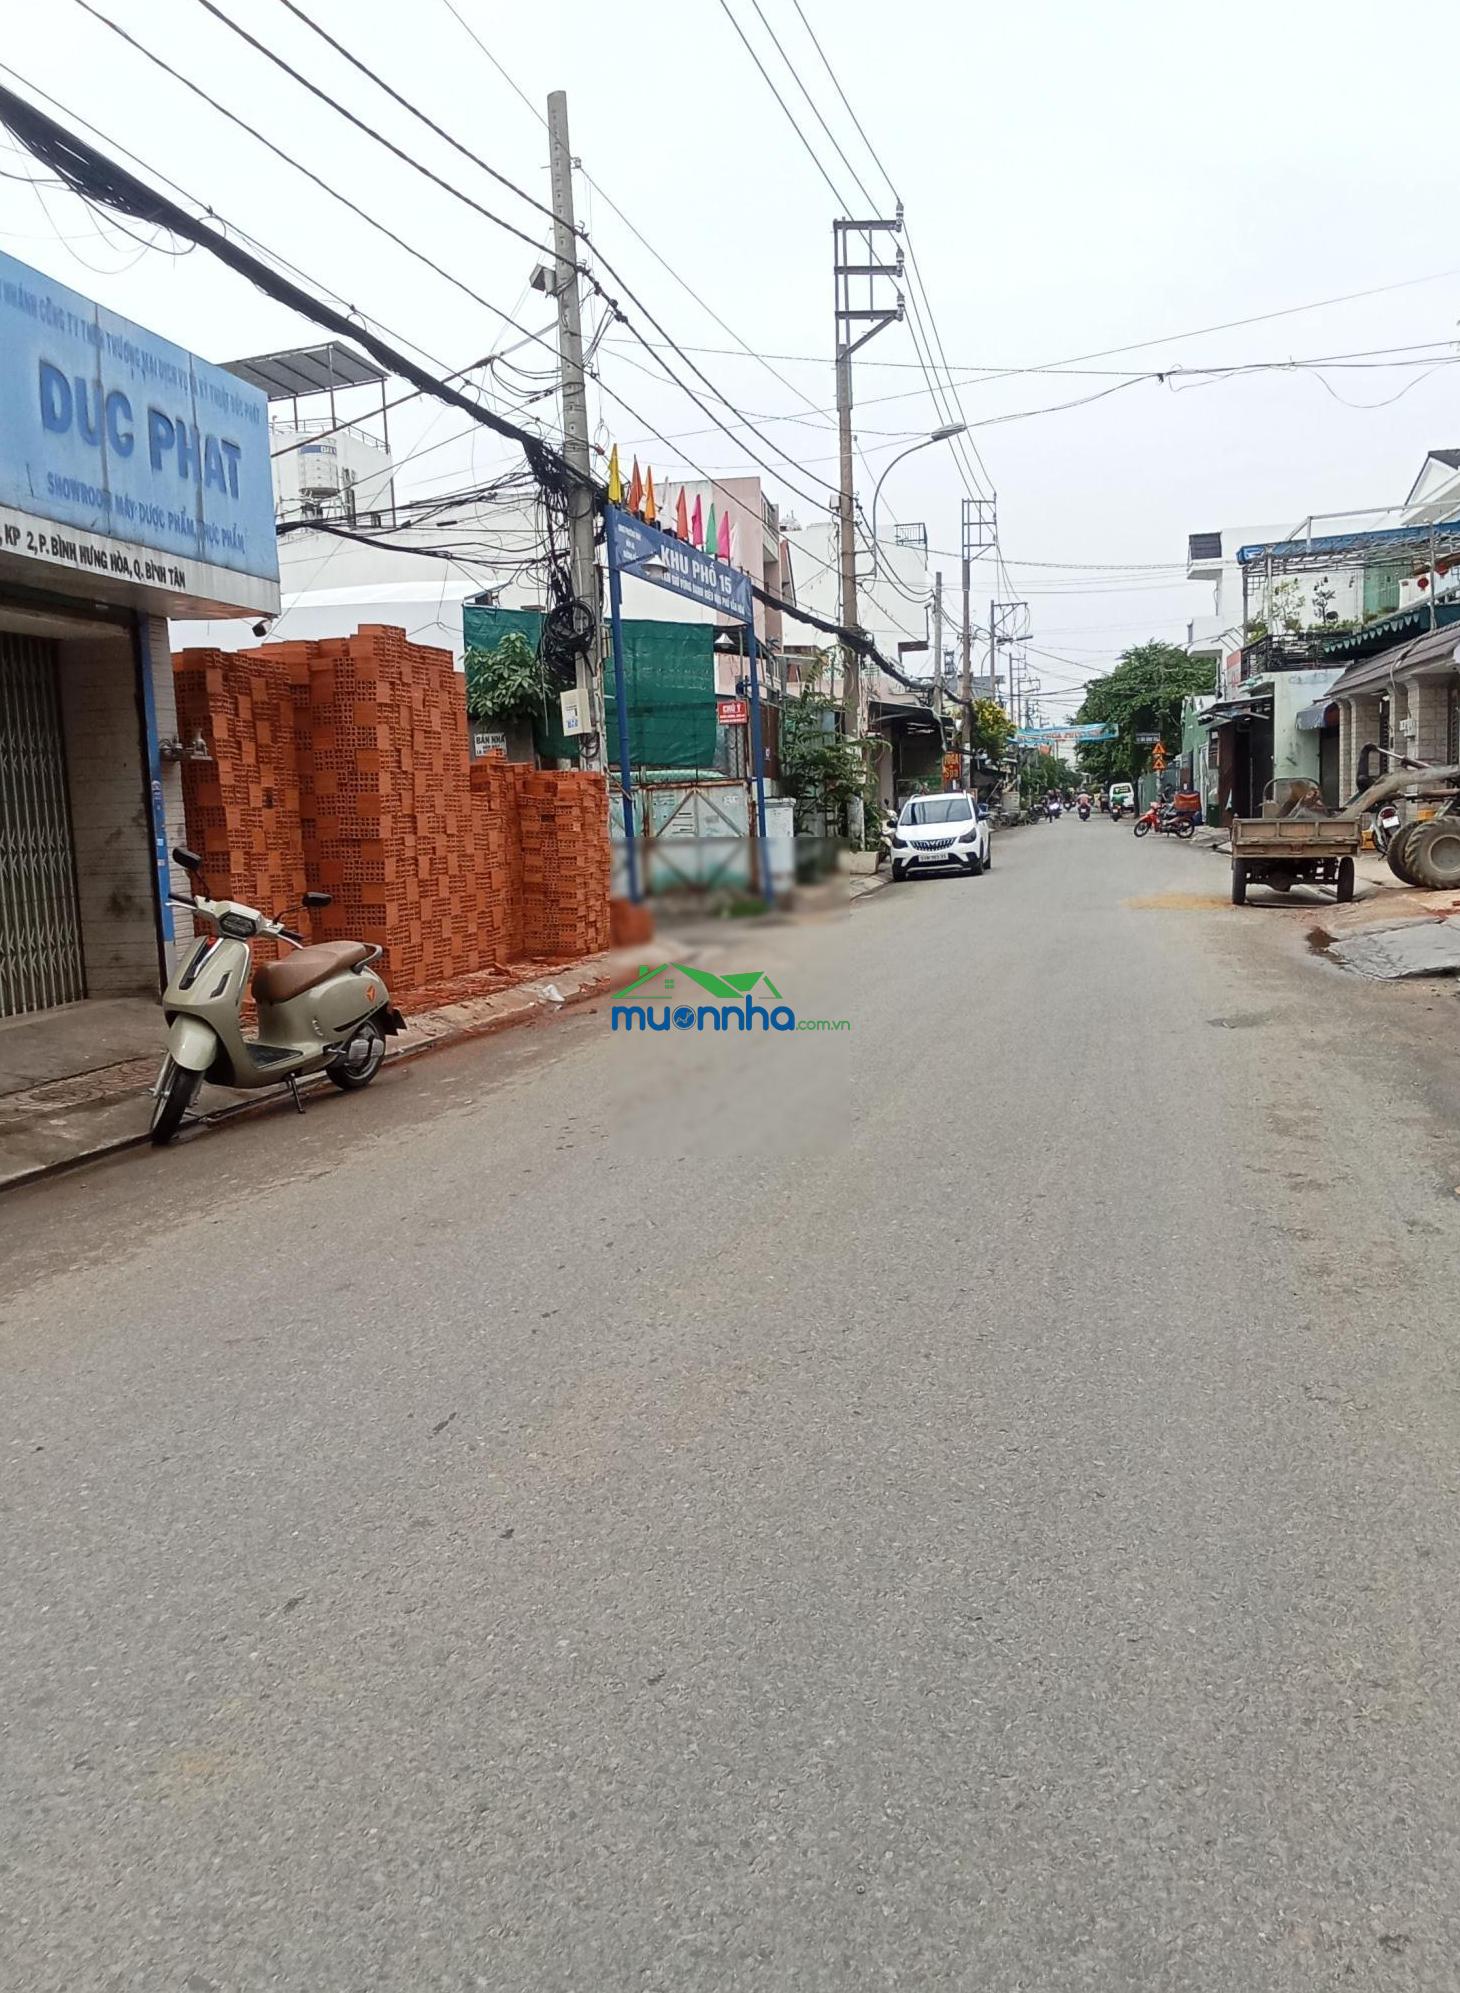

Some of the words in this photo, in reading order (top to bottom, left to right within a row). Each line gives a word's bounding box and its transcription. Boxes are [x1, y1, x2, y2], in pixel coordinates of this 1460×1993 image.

[3, 281, 37, 319] ÁNH
[47, 471, 112, 513] SHOWROO
[4, 524, 21, 547] KP
[51, 534, 77, 562] BÌNH
[145, 559, 166, 585] BÌNH
[168, 566, 186, 589] TÂN
[660, 544, 689, 574] KHU
[692, 559, 717, 588] PHỐ
[719, 574, 732, 595] 15
